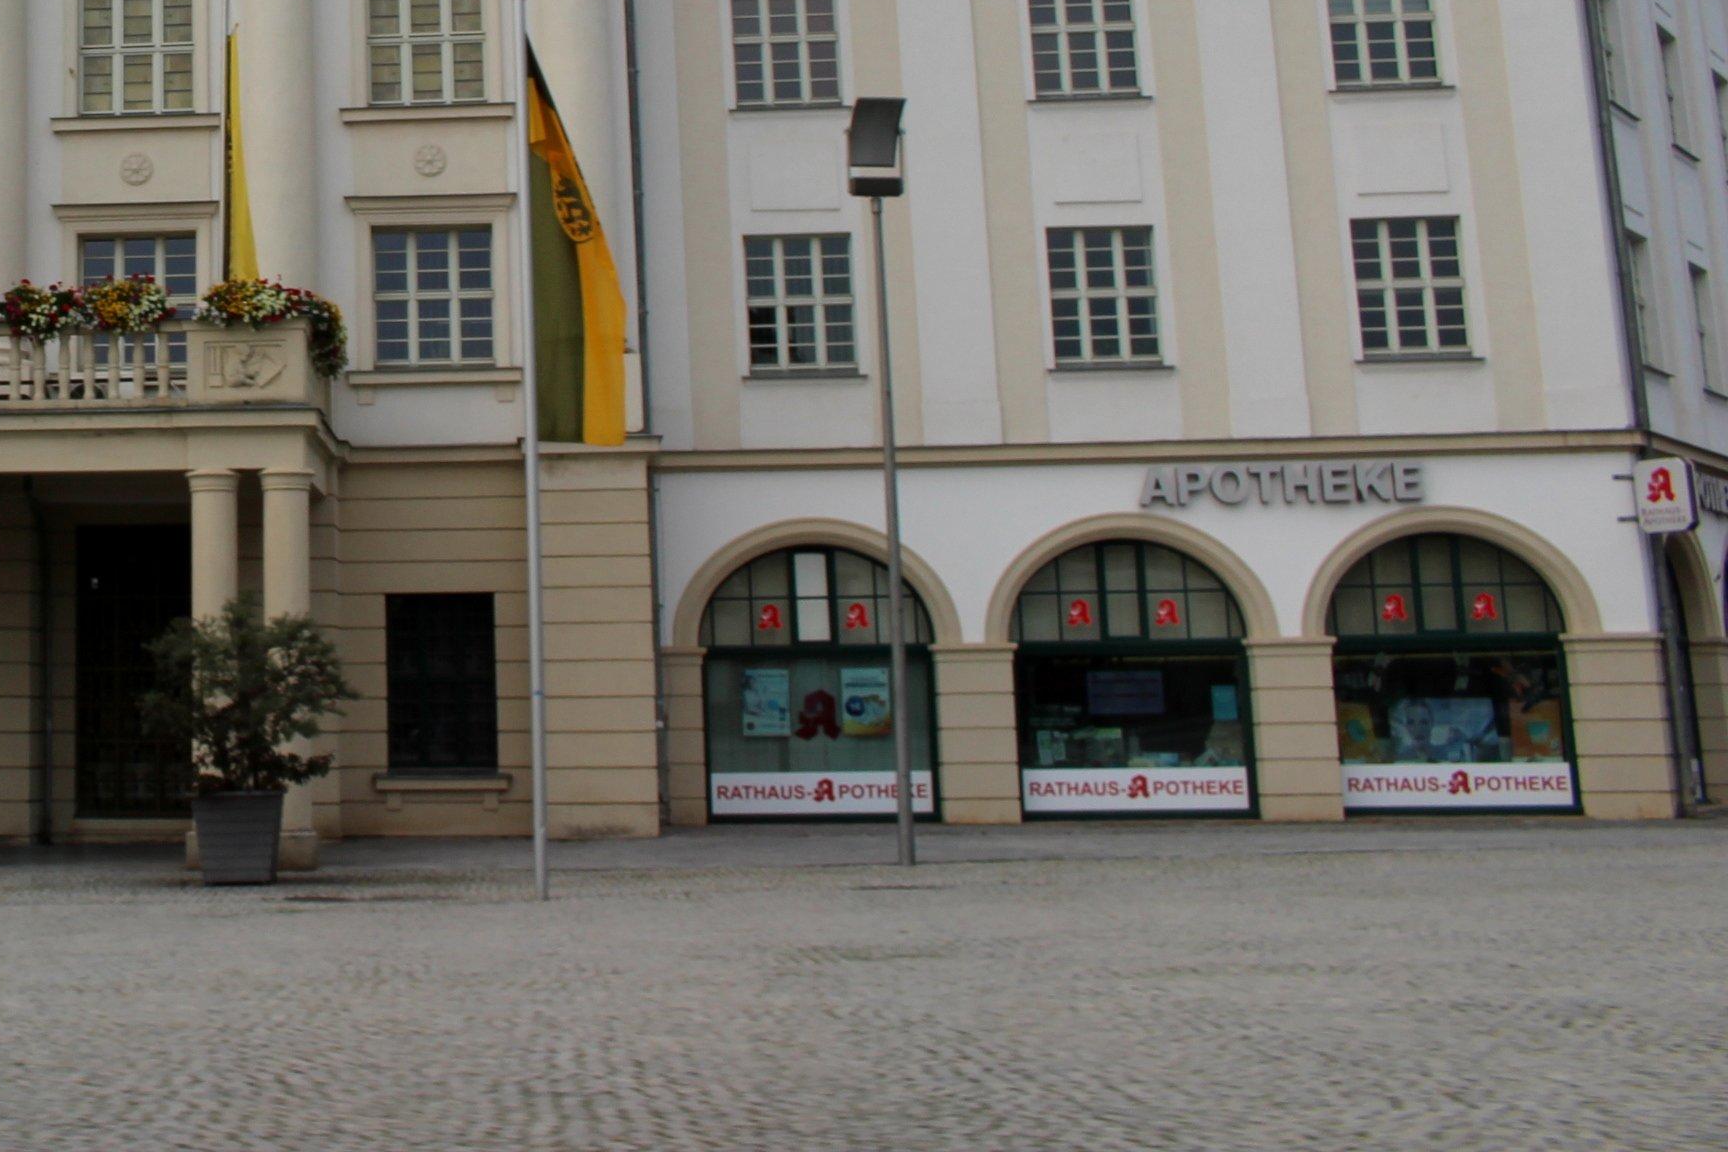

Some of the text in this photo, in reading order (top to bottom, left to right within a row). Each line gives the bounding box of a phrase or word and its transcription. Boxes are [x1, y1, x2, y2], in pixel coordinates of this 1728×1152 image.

[1140, 460, 1425, 508] APOTHEKE
[1028, 774, 1244, 799] RATHAUS-APOTHEKE
[1347, 769, 1569, 795] RATHAUS-APOTHEKE
